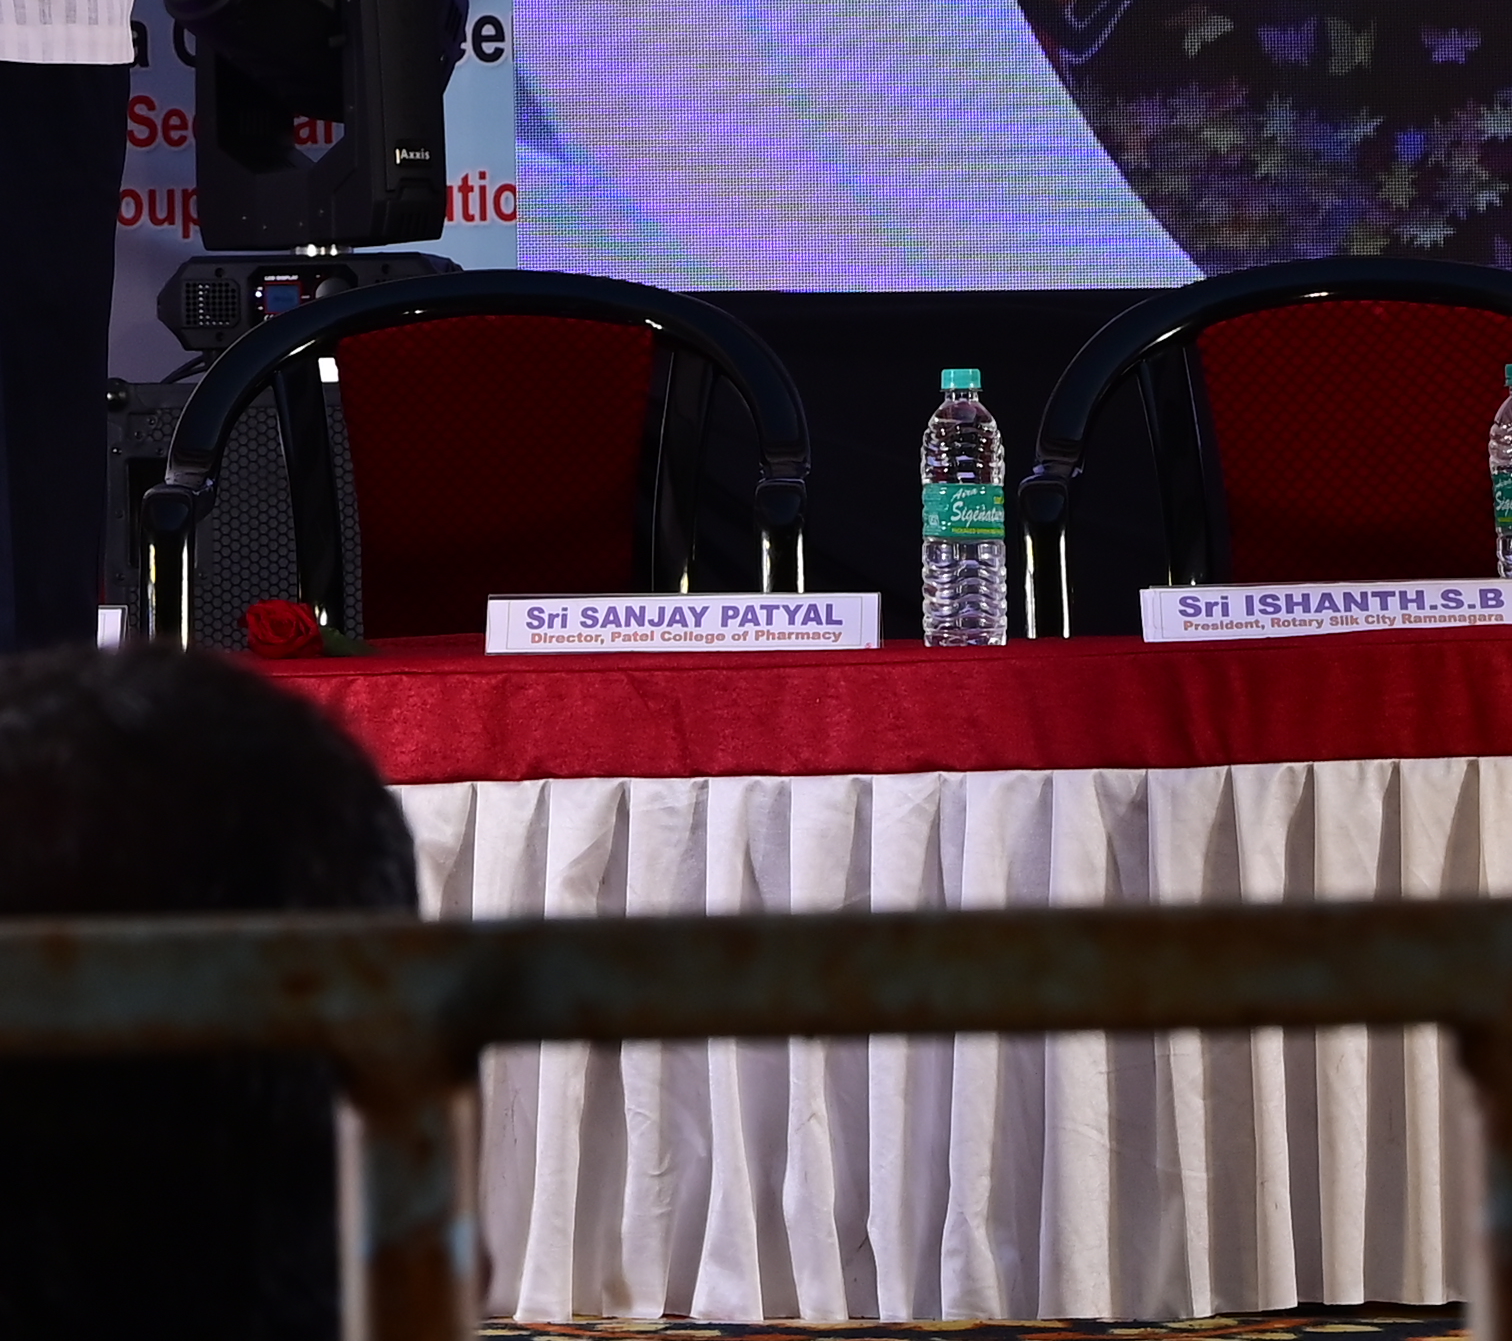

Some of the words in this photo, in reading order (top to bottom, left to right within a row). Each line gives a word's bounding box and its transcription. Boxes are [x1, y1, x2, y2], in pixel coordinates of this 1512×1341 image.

[400, 148, 431, 162] Axxis
[1177, 594, 1230, 619] Sri
[1245, 587, 1506, 618] ISHANTH.S.B
[525, 605, 569, 631] Sri
[579, 604, 710, 629] SANJAY
[720, 602, 844, 628] PATYAL
[1183, 618, 1266, 632] President,
[1270, 615, 1325, 630] Rotary
[1329, 614, 1361, 628] Silk
[1364, 613, 1397, 628] City
[1401, 612, 1505, 626] Ramanagara
[530, 630, 606, 646] Director,
[610, 630, 655, 644] Patel
[660, 630, 726, 645] College
[731, 629, 750, 643] of
[754, 628, 843, 644] Pharmacy
